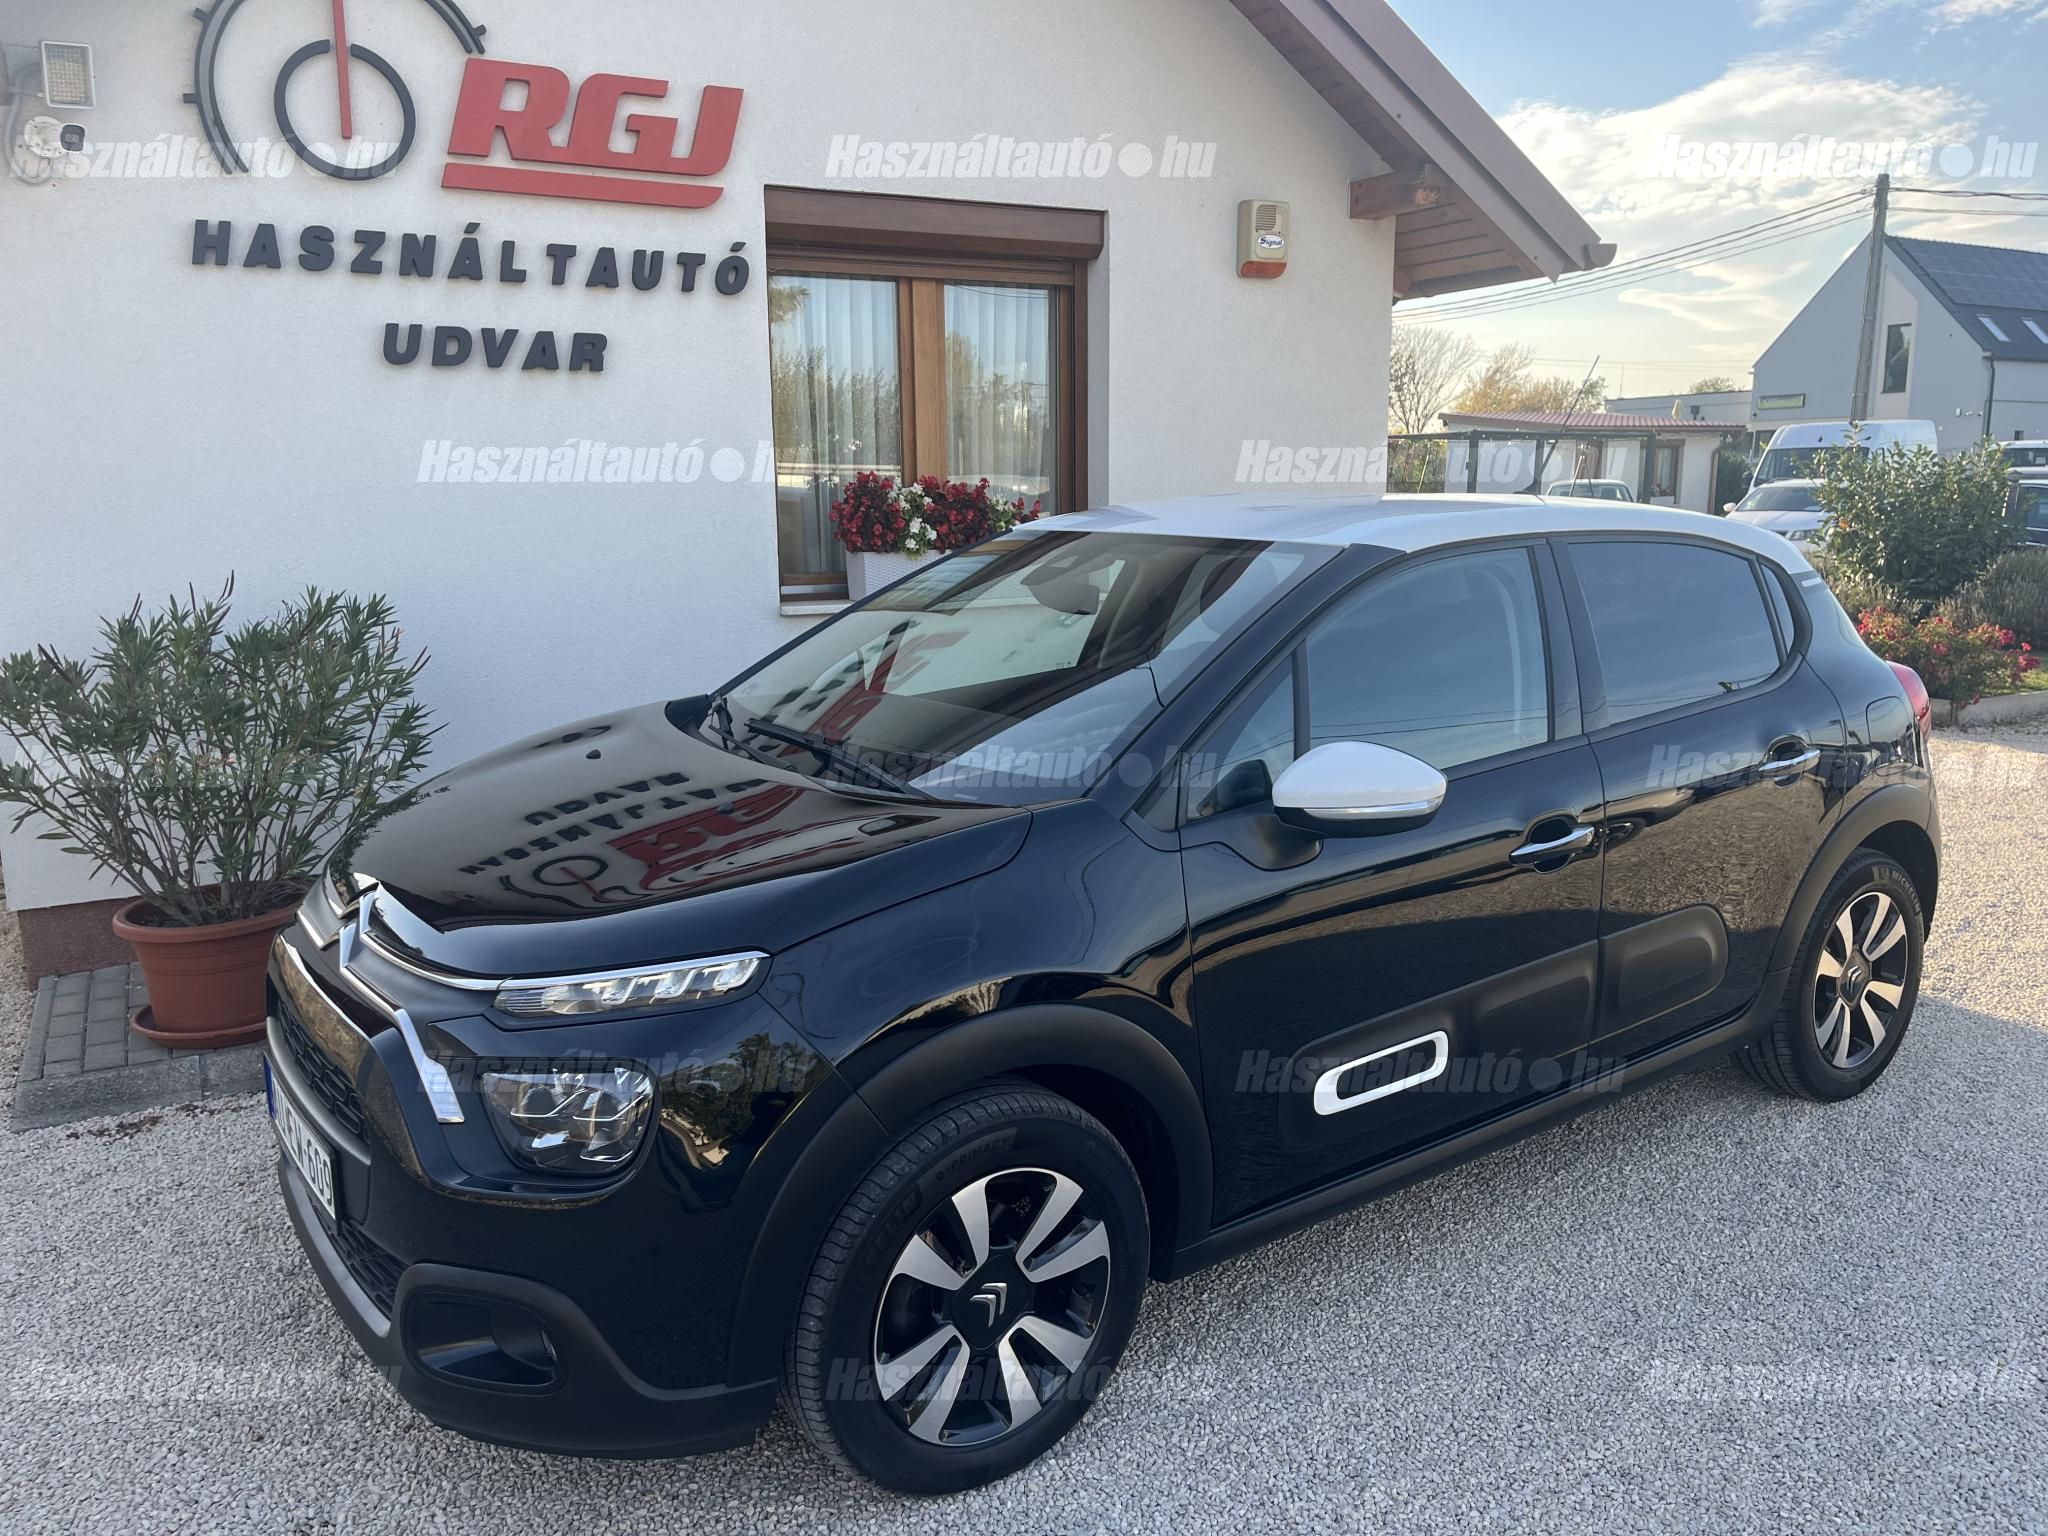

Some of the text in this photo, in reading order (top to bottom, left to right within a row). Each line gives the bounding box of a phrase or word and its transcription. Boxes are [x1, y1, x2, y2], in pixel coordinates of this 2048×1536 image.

[447, 57, 745, 176] RGJ
[191, 219, 750, 296] HASZNÁLTAUTÓ
[382, 322, 609, 372] UDVAR
